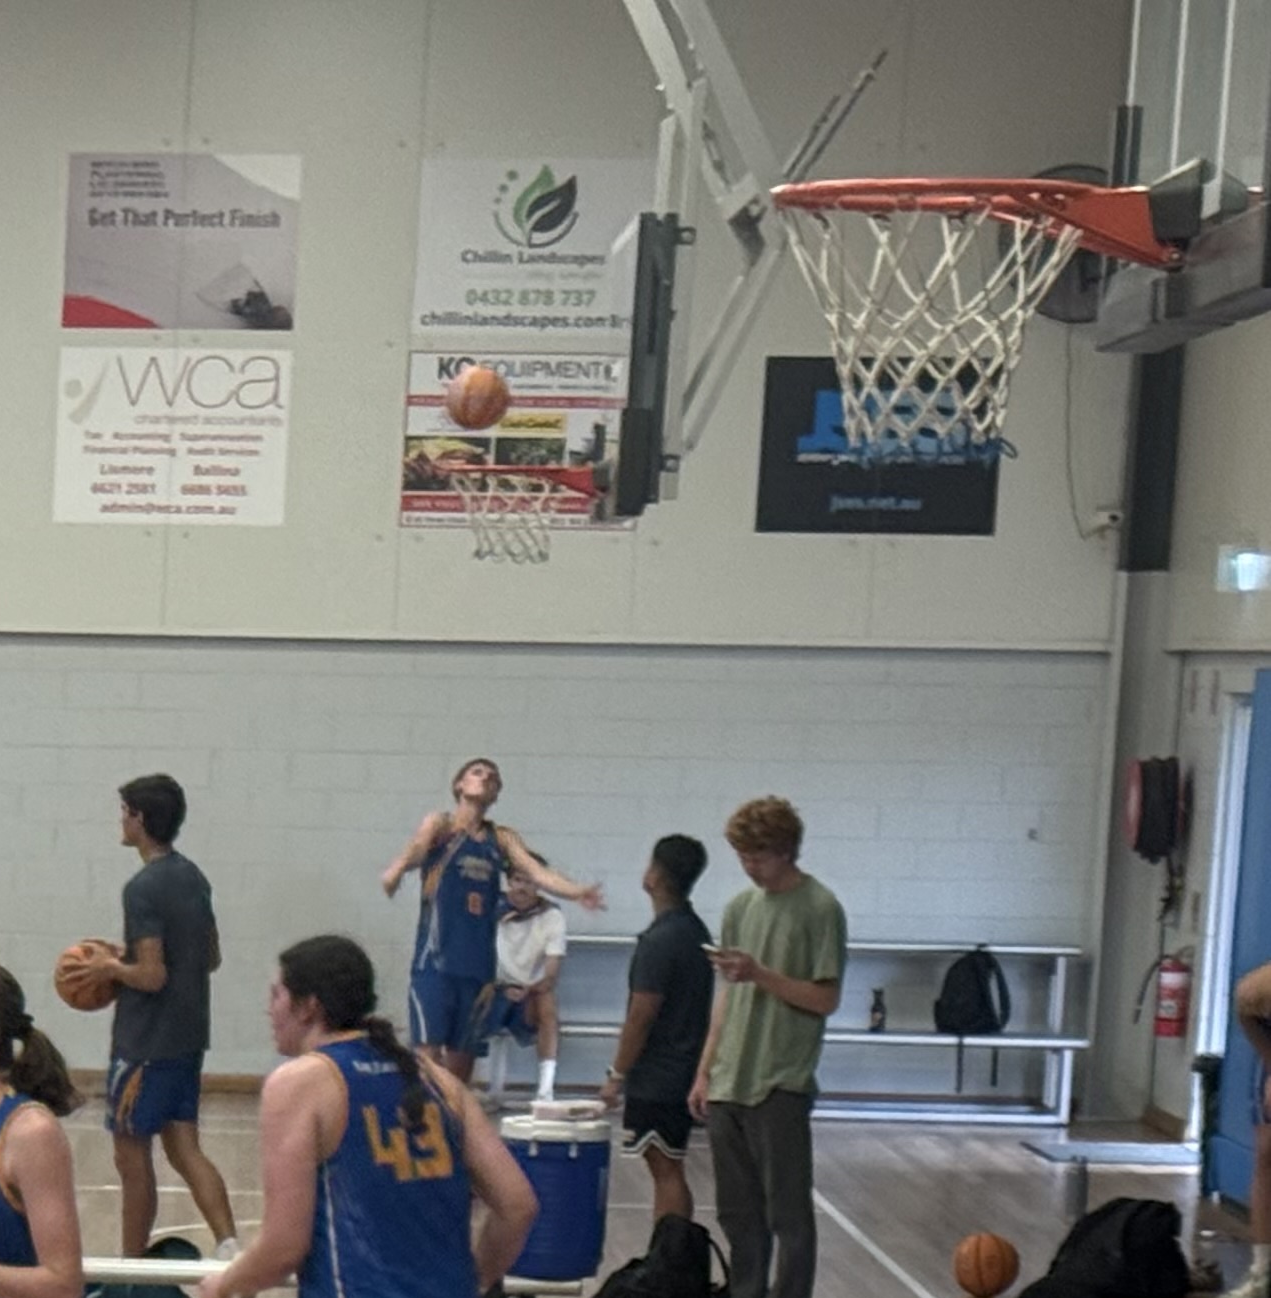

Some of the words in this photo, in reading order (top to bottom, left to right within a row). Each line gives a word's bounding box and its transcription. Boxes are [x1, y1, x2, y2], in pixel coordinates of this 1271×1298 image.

[121, 208, 157, 228] That
[163, 209, 225, 228] Perfect
[465, 289, 513, 306] 0432
[561, 290, 596, 307] 737
[362, 1102, 454, 1183] 43
